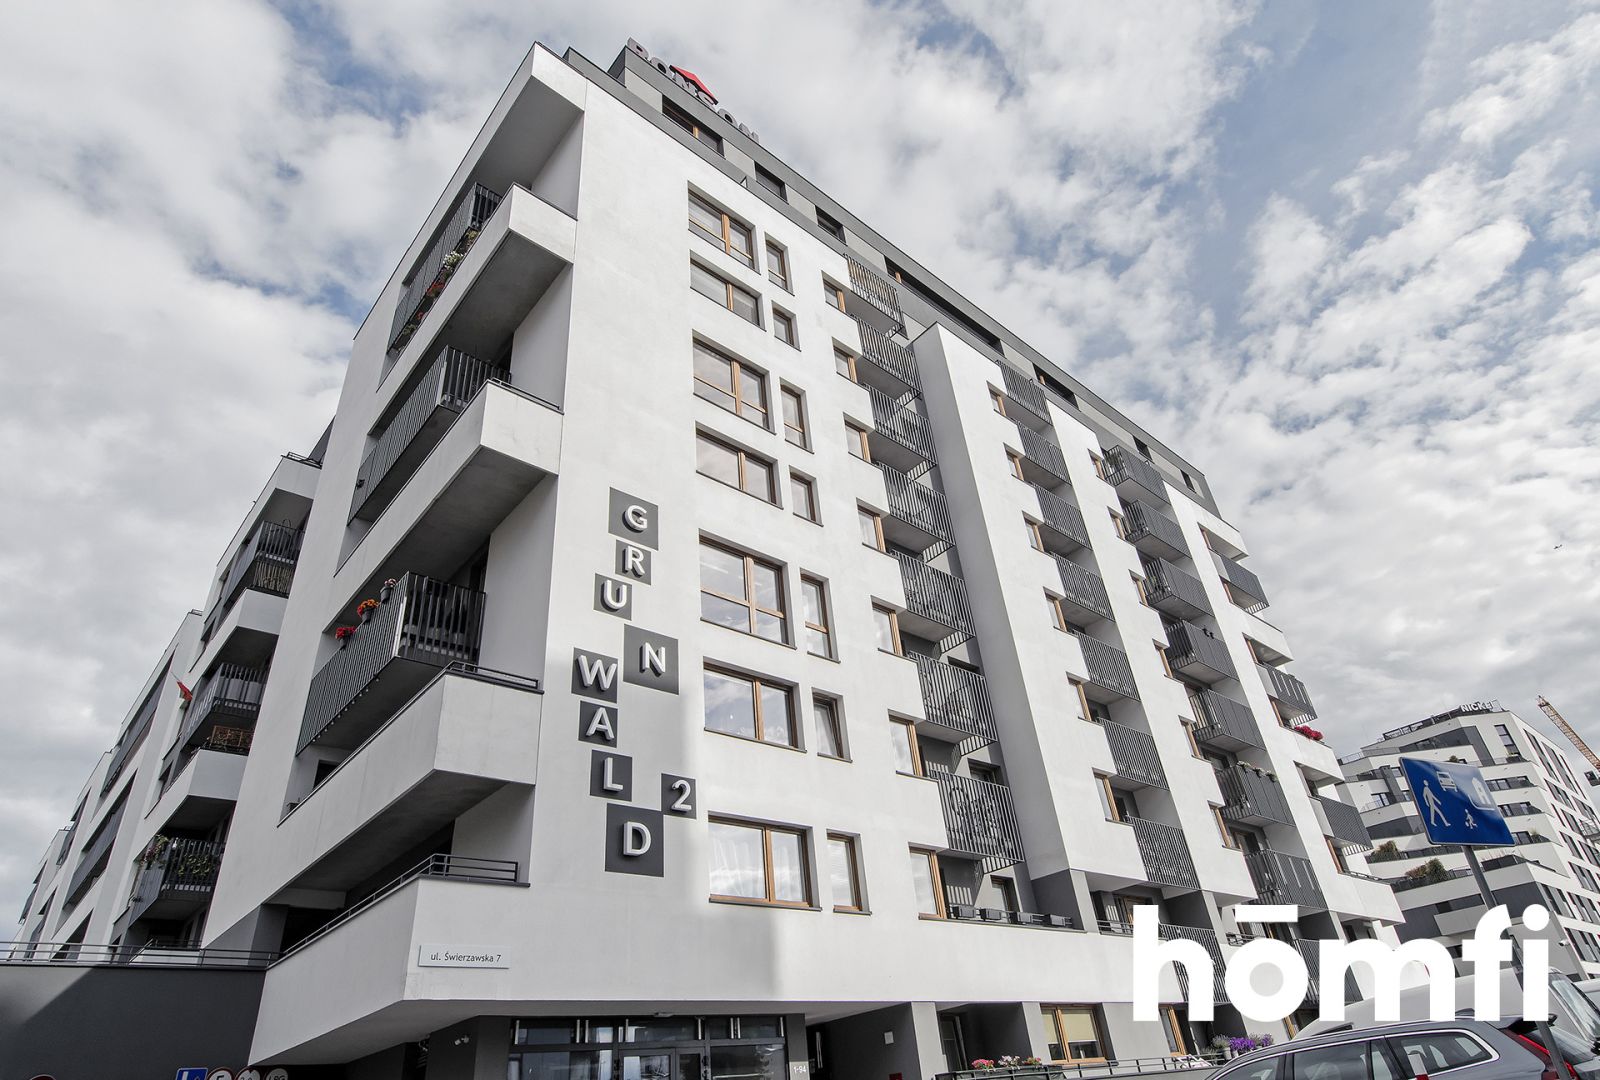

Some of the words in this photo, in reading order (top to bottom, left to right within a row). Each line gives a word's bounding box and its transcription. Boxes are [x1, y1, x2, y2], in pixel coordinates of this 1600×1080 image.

[671, 779, 692, 811] 2
[430, 952, 441, 961] ul.
[444, 951, 494, 962] Świerzawska
[496, 954, 501, 962] 7
